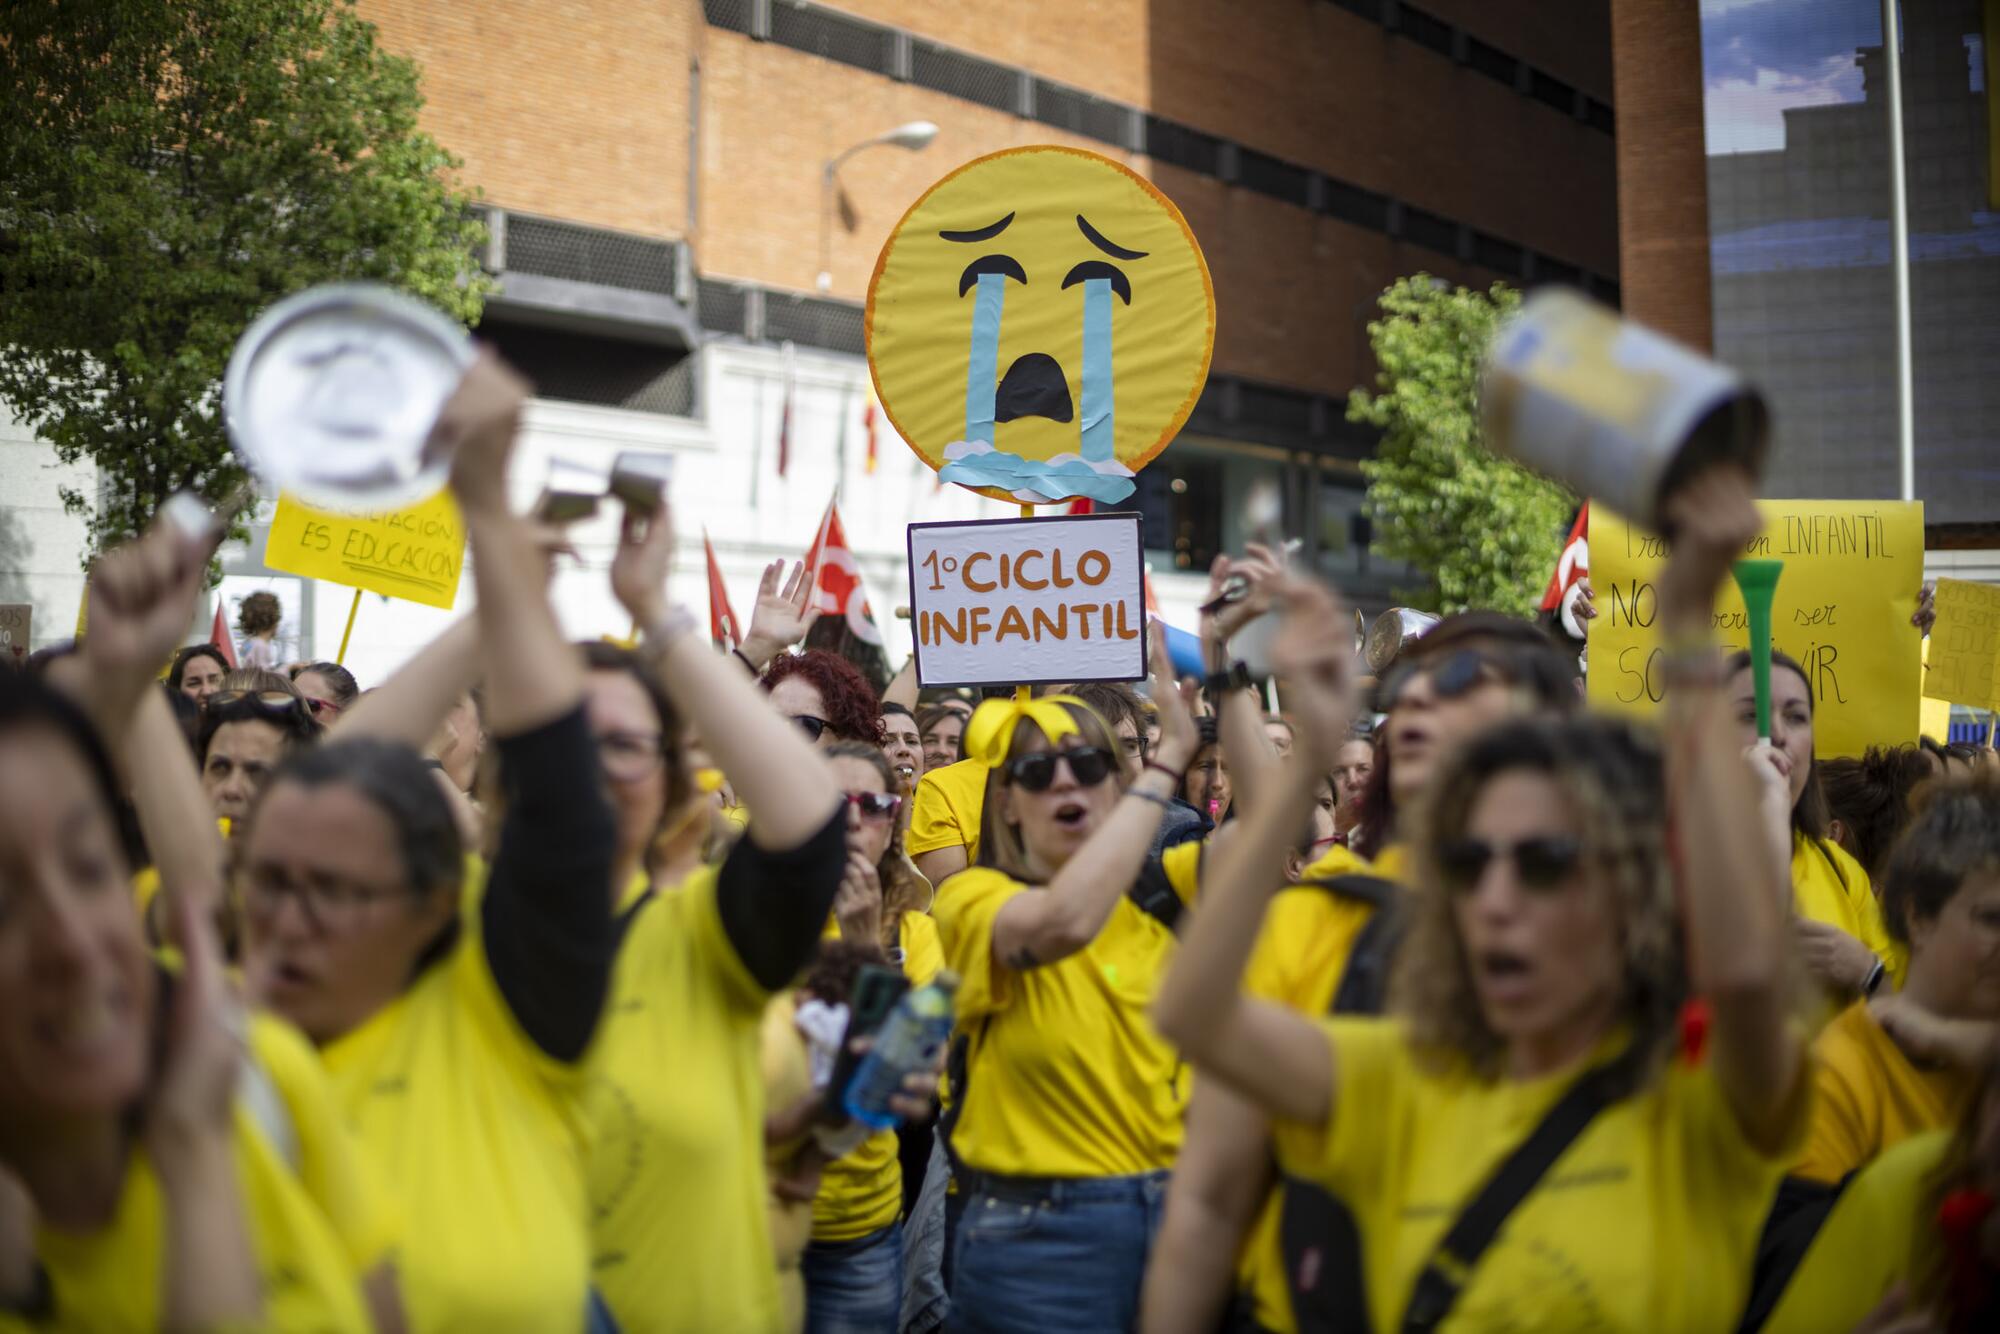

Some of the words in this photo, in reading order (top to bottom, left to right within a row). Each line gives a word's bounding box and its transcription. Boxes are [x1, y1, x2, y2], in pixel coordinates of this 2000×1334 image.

[301, 521, 332, 551] ES
[920, 600, 1139, 646] INFANTIL
[1611, 578, 1658, 628] NO
[1793, 603, 1837, 627] ser
